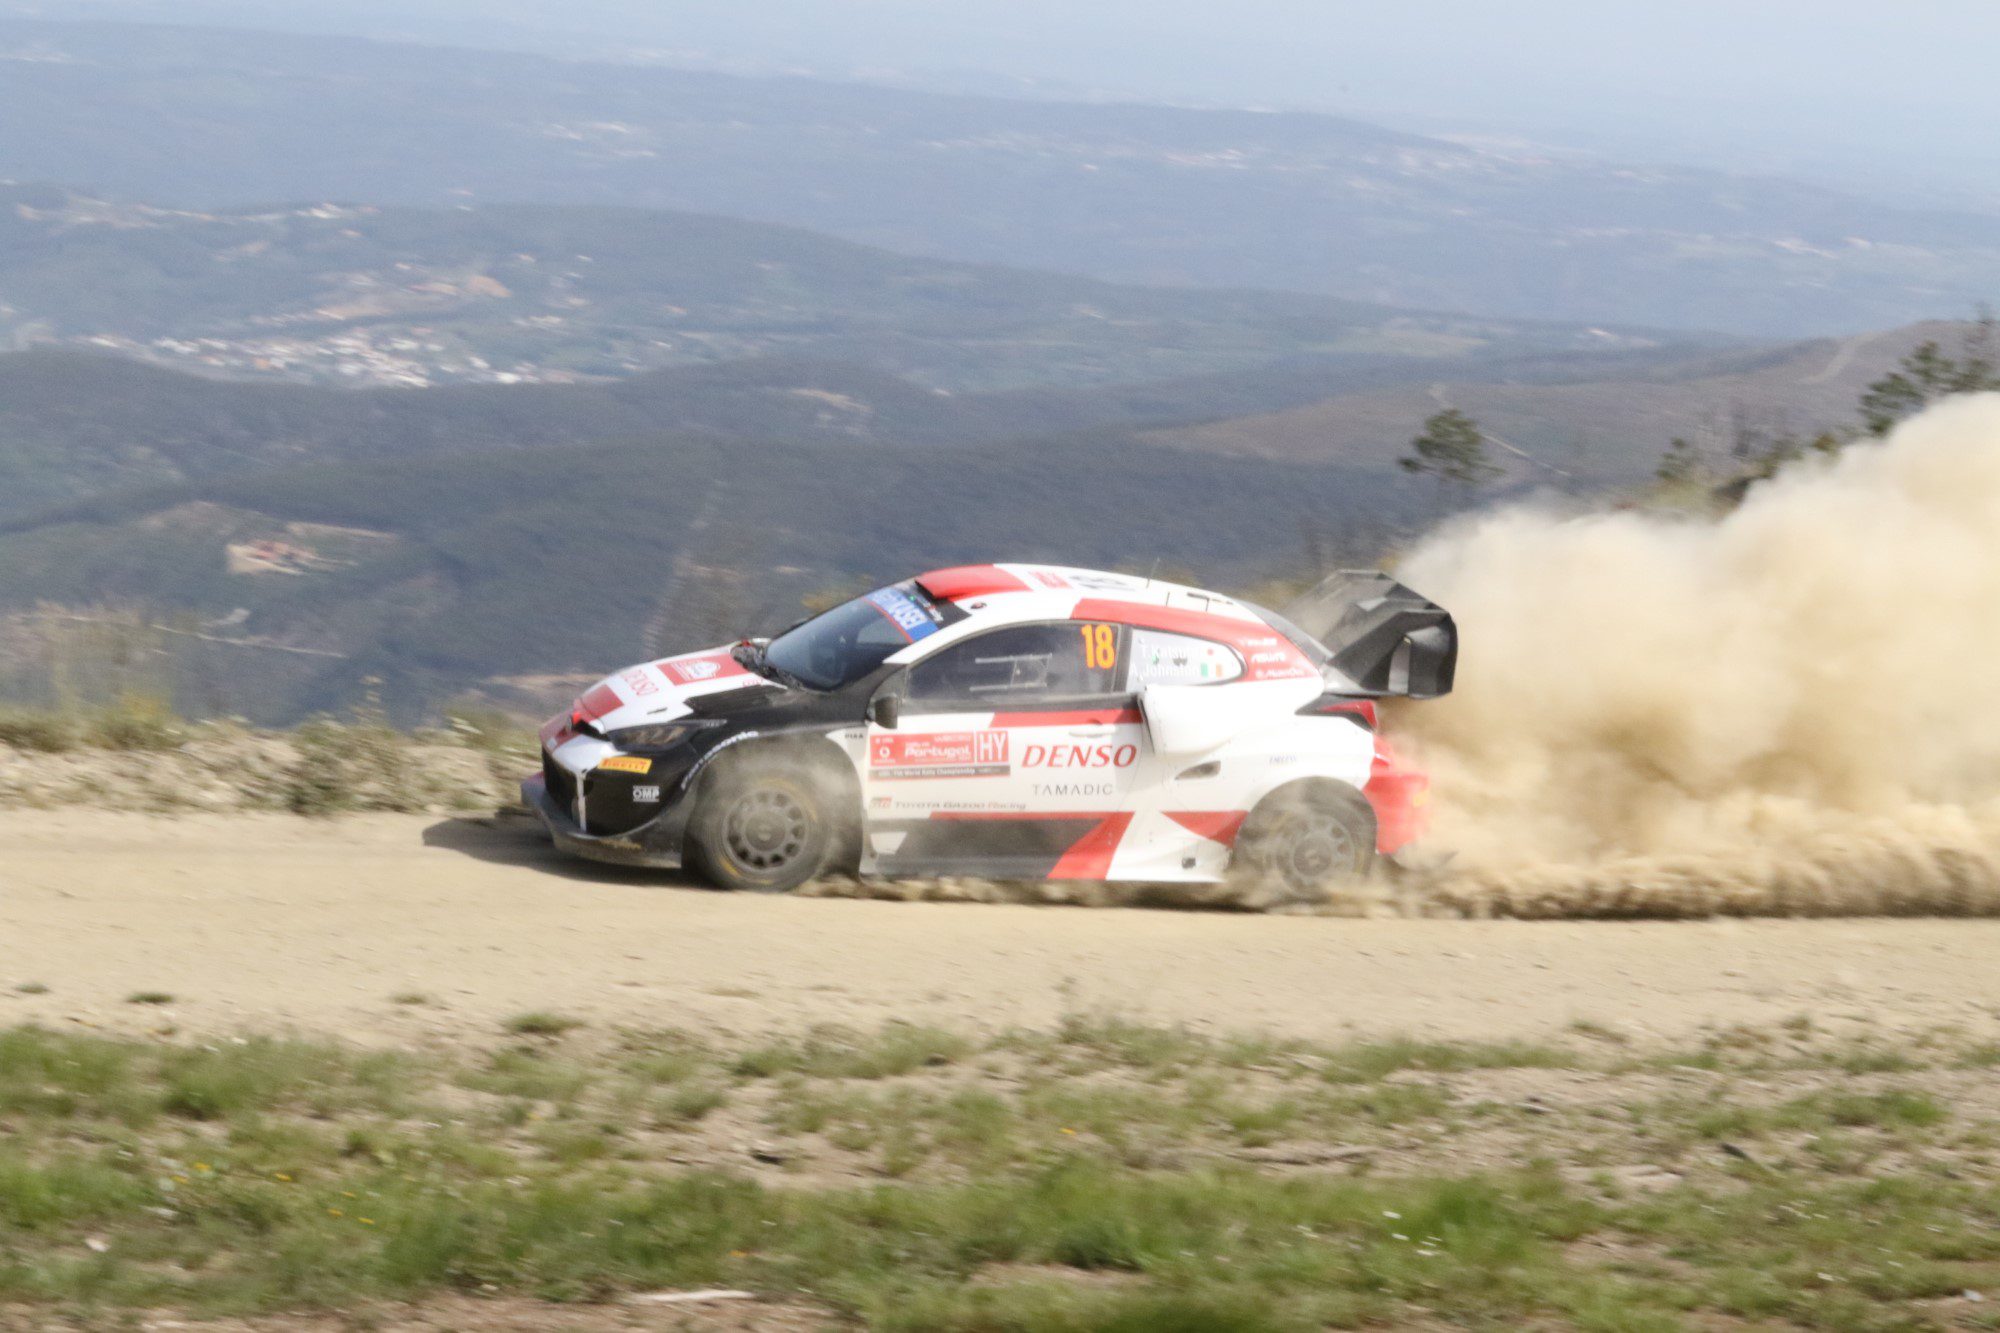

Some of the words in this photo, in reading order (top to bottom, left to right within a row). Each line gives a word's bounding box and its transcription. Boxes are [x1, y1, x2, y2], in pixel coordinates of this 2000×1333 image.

[1081, 624, 1115, 669] 18
[980, 733, 1006, 760] HY
[1022, 744, 1137, 768] DENSO
[633, 788, 659, 800] OMP
[1033, 783, 1113, 796] TAMADIC
